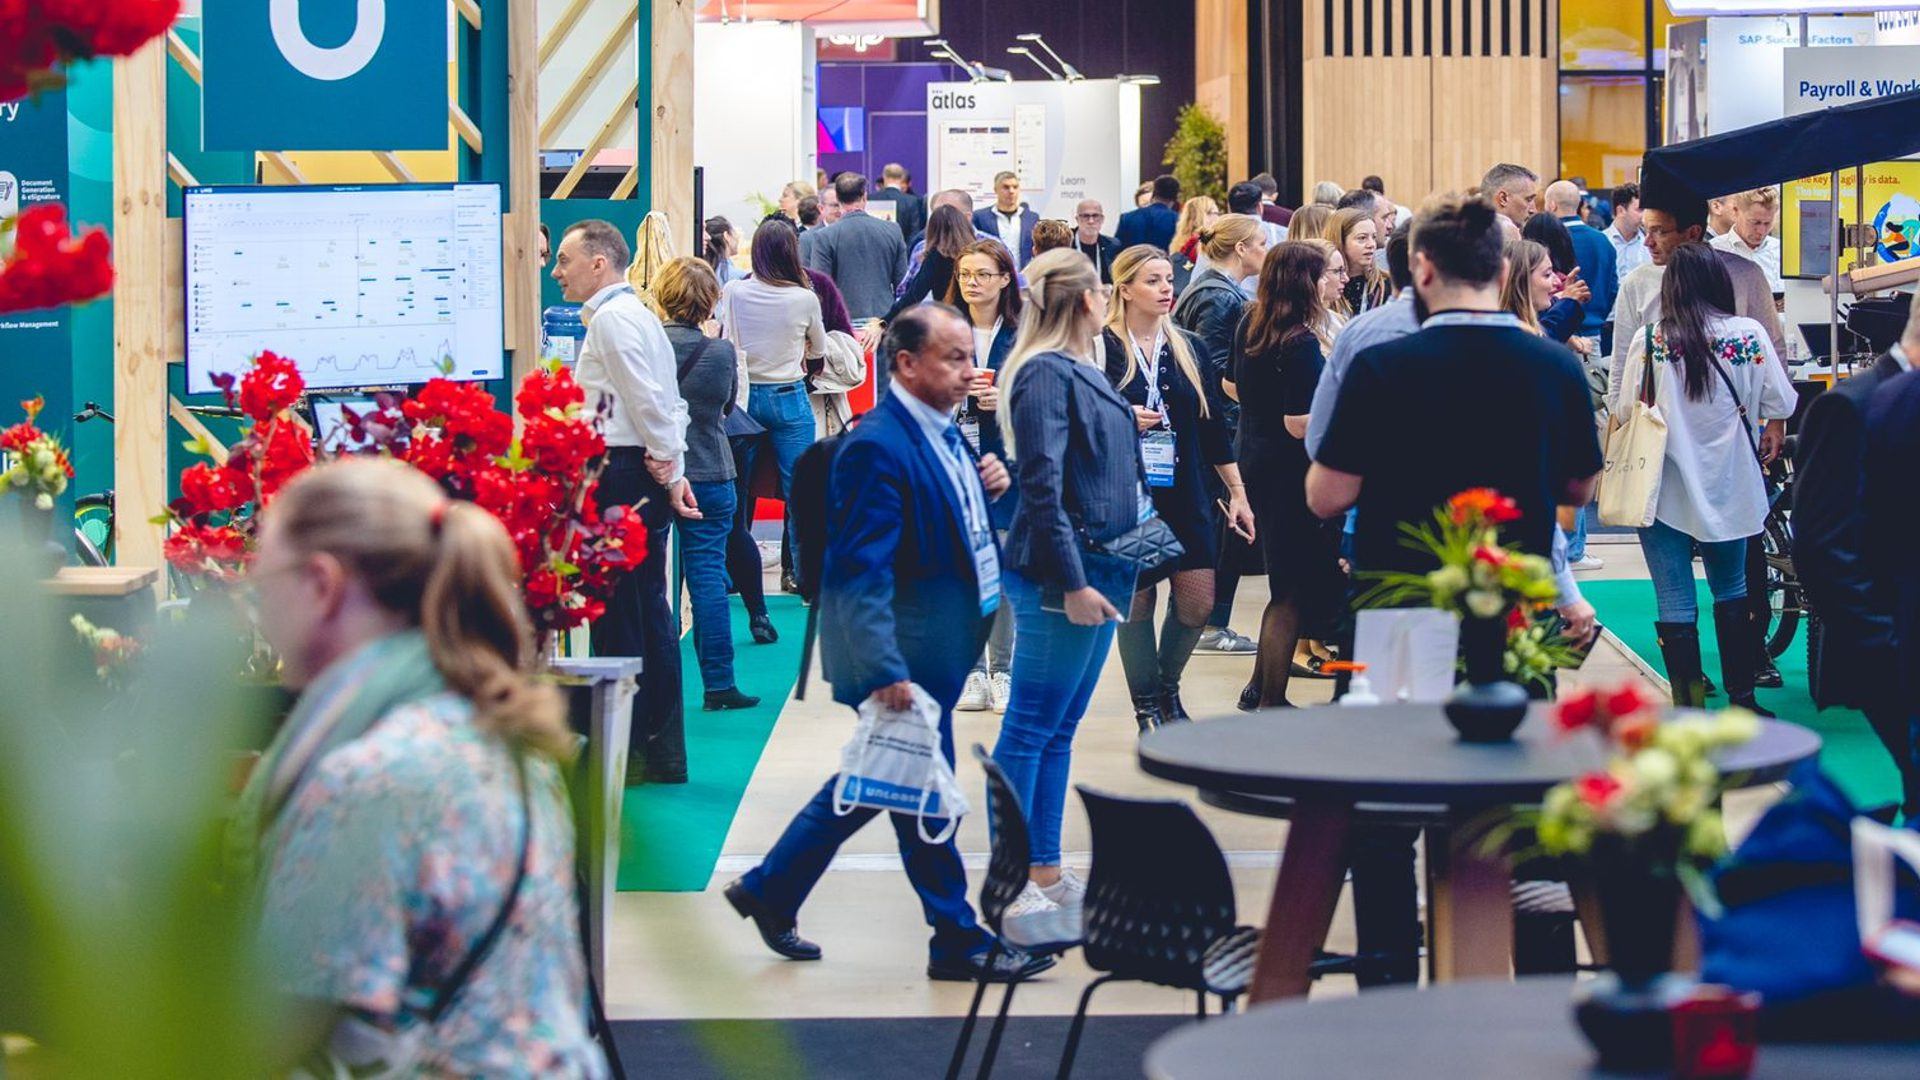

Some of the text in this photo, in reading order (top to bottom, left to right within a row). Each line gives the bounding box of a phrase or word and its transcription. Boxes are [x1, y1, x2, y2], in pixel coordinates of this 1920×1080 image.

[1739, 34, 1762, 44] SAP
[1799, 80, 1855, 101] Payroll
[1859, 81, 1872, 97] &
[932, 91, 976, 109] atlas
[1060, 175, 1086, 186] Learn
[1812, 175, 1828, 185] key
[1869, 175, 1876, 184] is
[1878, 175, 1901, 184] data.
[19, 321, 59, 329] Management
